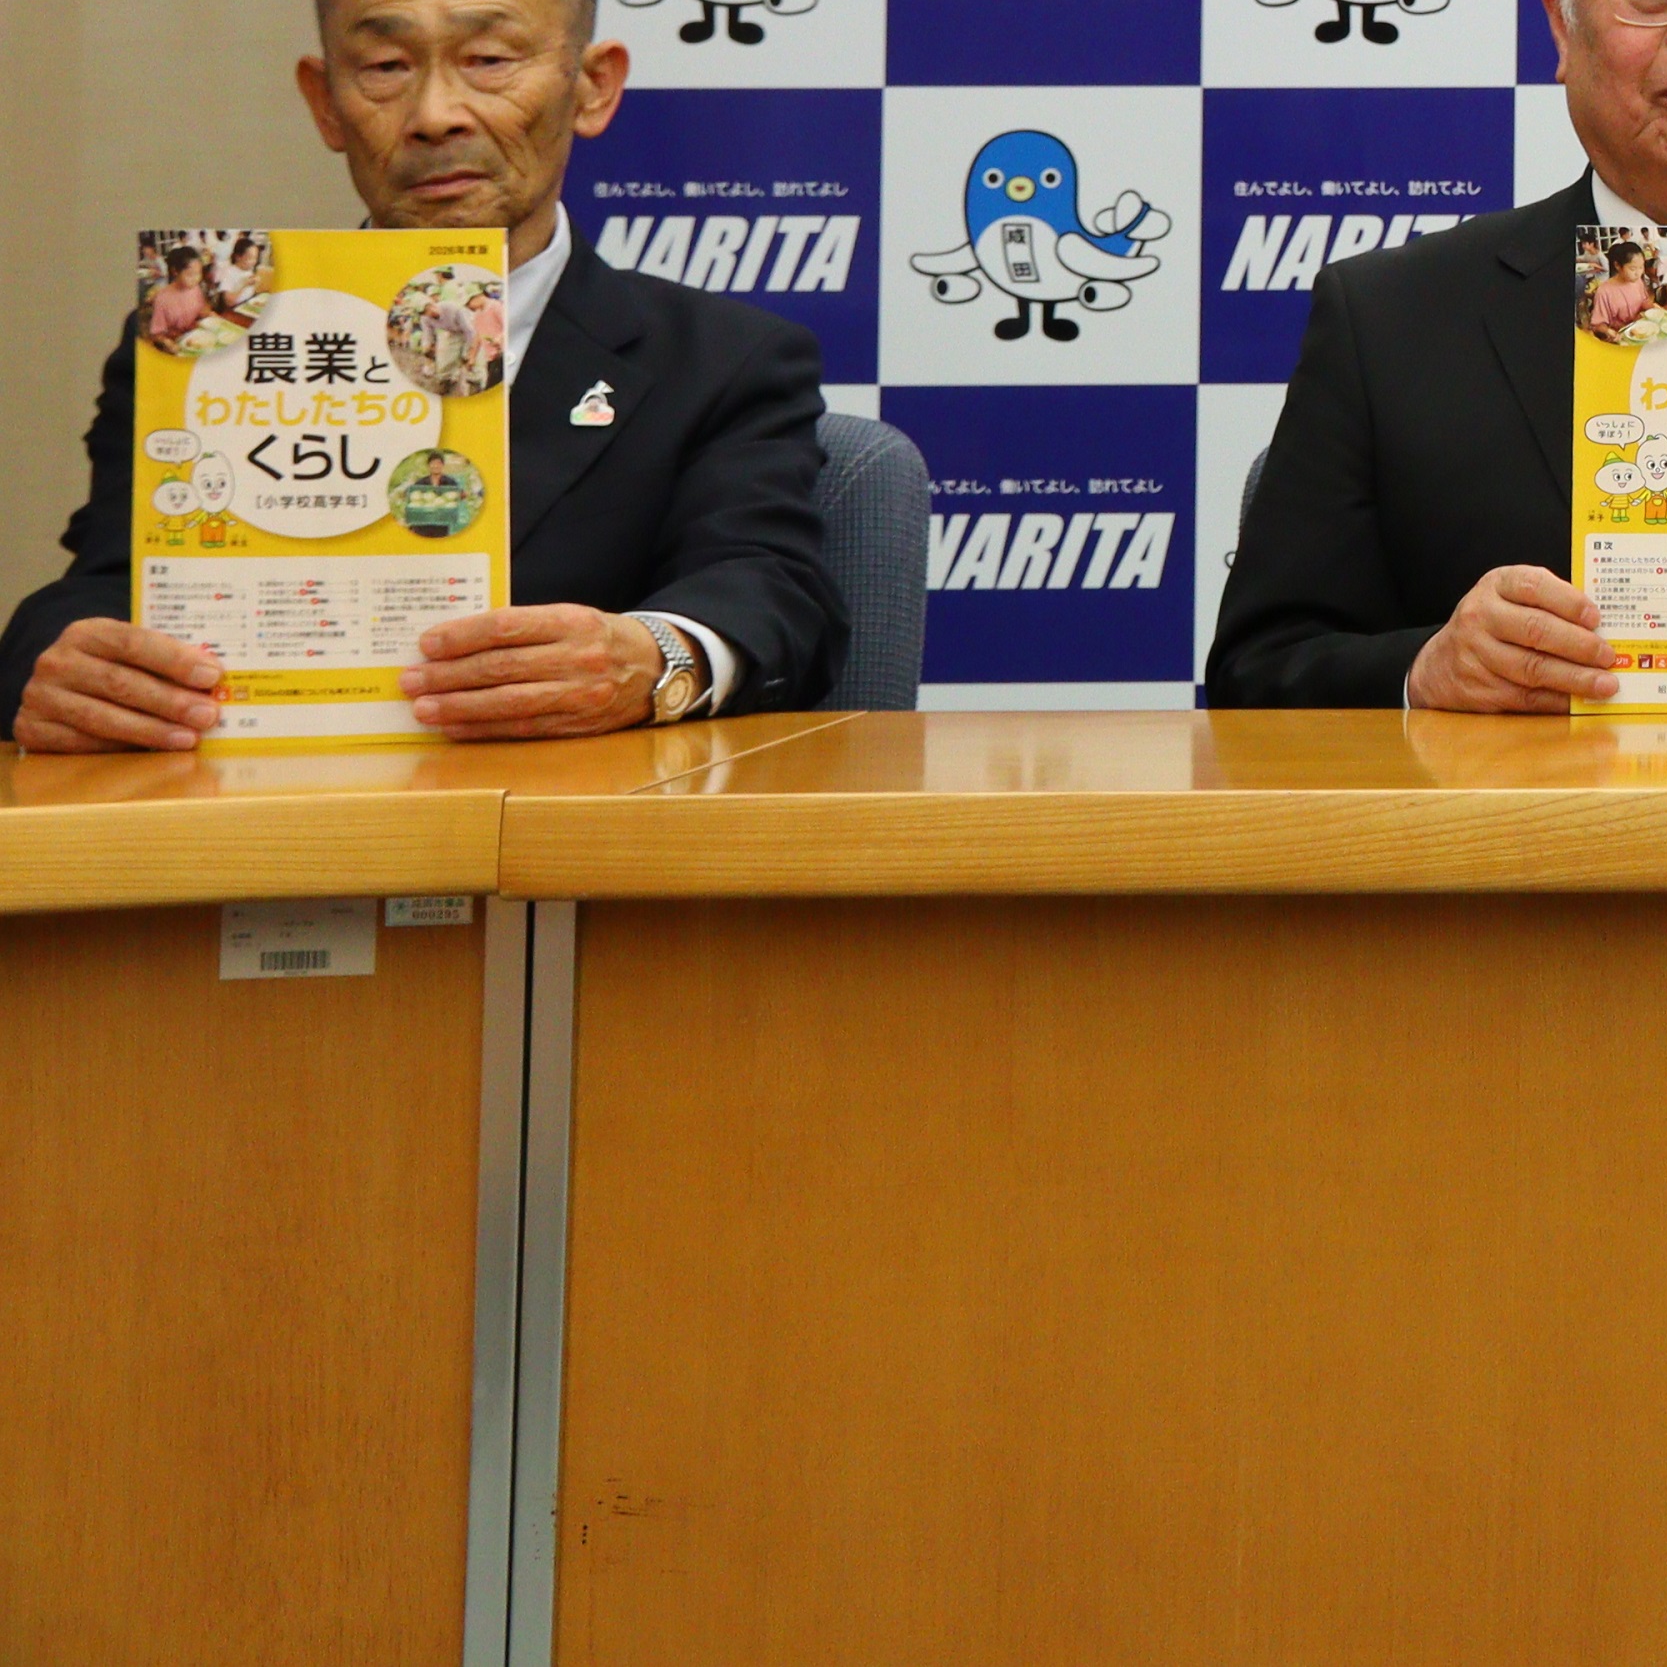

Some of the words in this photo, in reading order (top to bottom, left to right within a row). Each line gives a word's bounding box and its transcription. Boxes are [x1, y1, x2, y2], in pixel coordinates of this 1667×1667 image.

[1232, 180, 1482, 197] 住んでよし、働いてよし、訪れてよし
[596, 216, 860, 292] NARITA
[1006, 228, 1031, 277] 成田
[245, 333, 388, 384] 農業と
[196, 390, 430, 427] わたしたちの
[1596, 421, 1635, 429] いっしょに
[248, 435, 380, 481] くらし
[1593, 541, 1613, 550] 目次
[1657, 685, 1667, 694] 組
